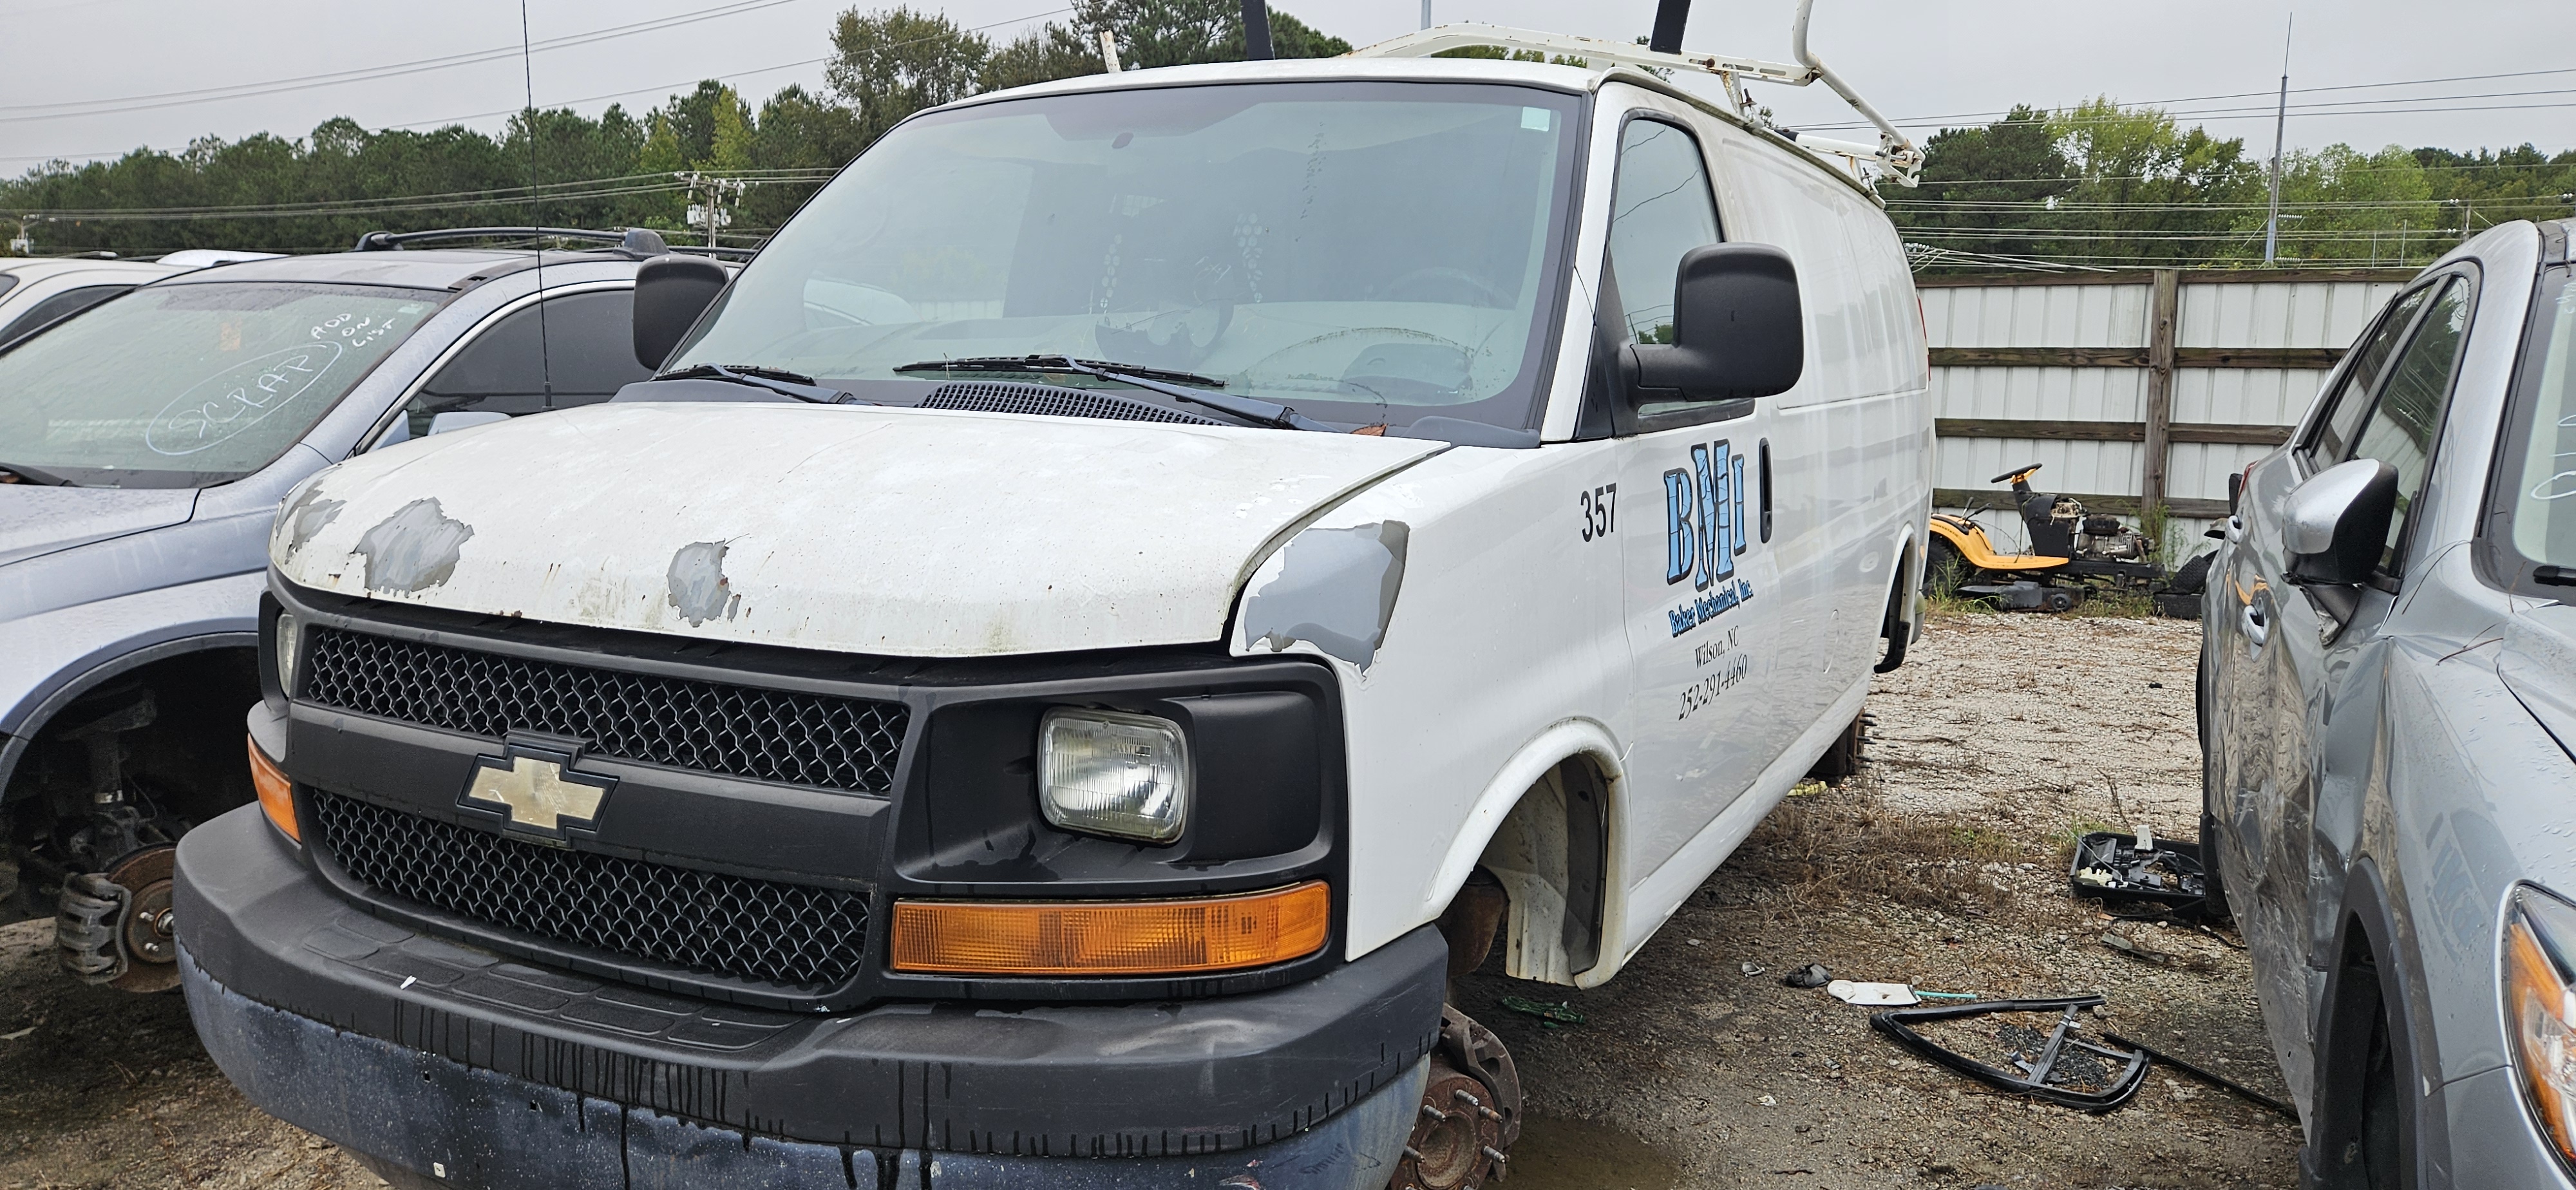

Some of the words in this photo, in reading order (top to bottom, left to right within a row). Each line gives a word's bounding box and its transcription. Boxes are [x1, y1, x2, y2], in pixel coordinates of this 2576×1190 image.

[168, 355, 314, 439] SCRAP
[1580, 482, 1616, 542] 357
[1663, 438, 1747, 592] BMI
[1668, 603, 1696, 638] Baker
[1694, 580, 1741, 625] Mechanical,
[1738, 578, 1754, 603] Inc.
[1694, 640, 1725, 669] Wilson,
[1727, 625, 1739, 651] NC
[1678, 653, 1748, 721] 252-291-4460
